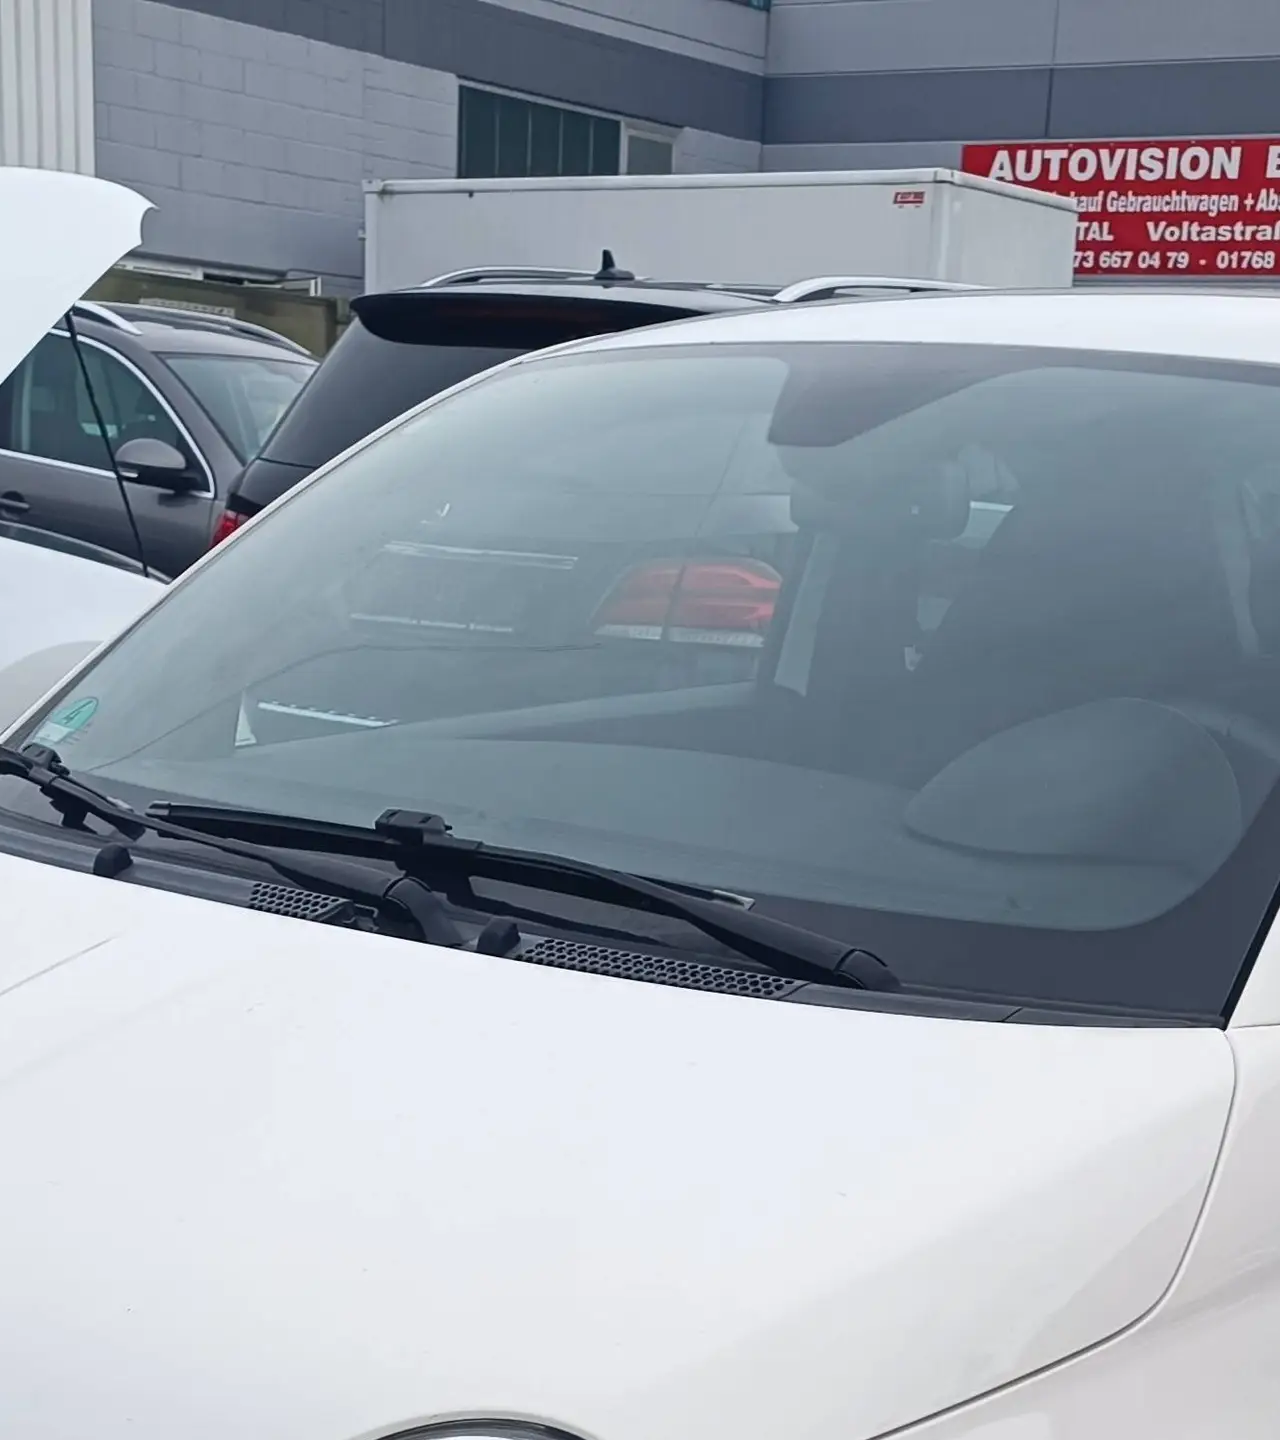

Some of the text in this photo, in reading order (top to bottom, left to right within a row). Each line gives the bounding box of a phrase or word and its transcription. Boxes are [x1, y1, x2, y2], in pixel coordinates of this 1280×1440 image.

[988, 145, 1242, 182] AUTOVISION
[1106, 189, 1238, 217] Gebrauchtwagen
[1099, 250, 1134, 269] 667
[1137, 250, 1161, 269] 04
[1165, 250, 1190, 269] 79
[1216, 250, 1276, 269] 01768
